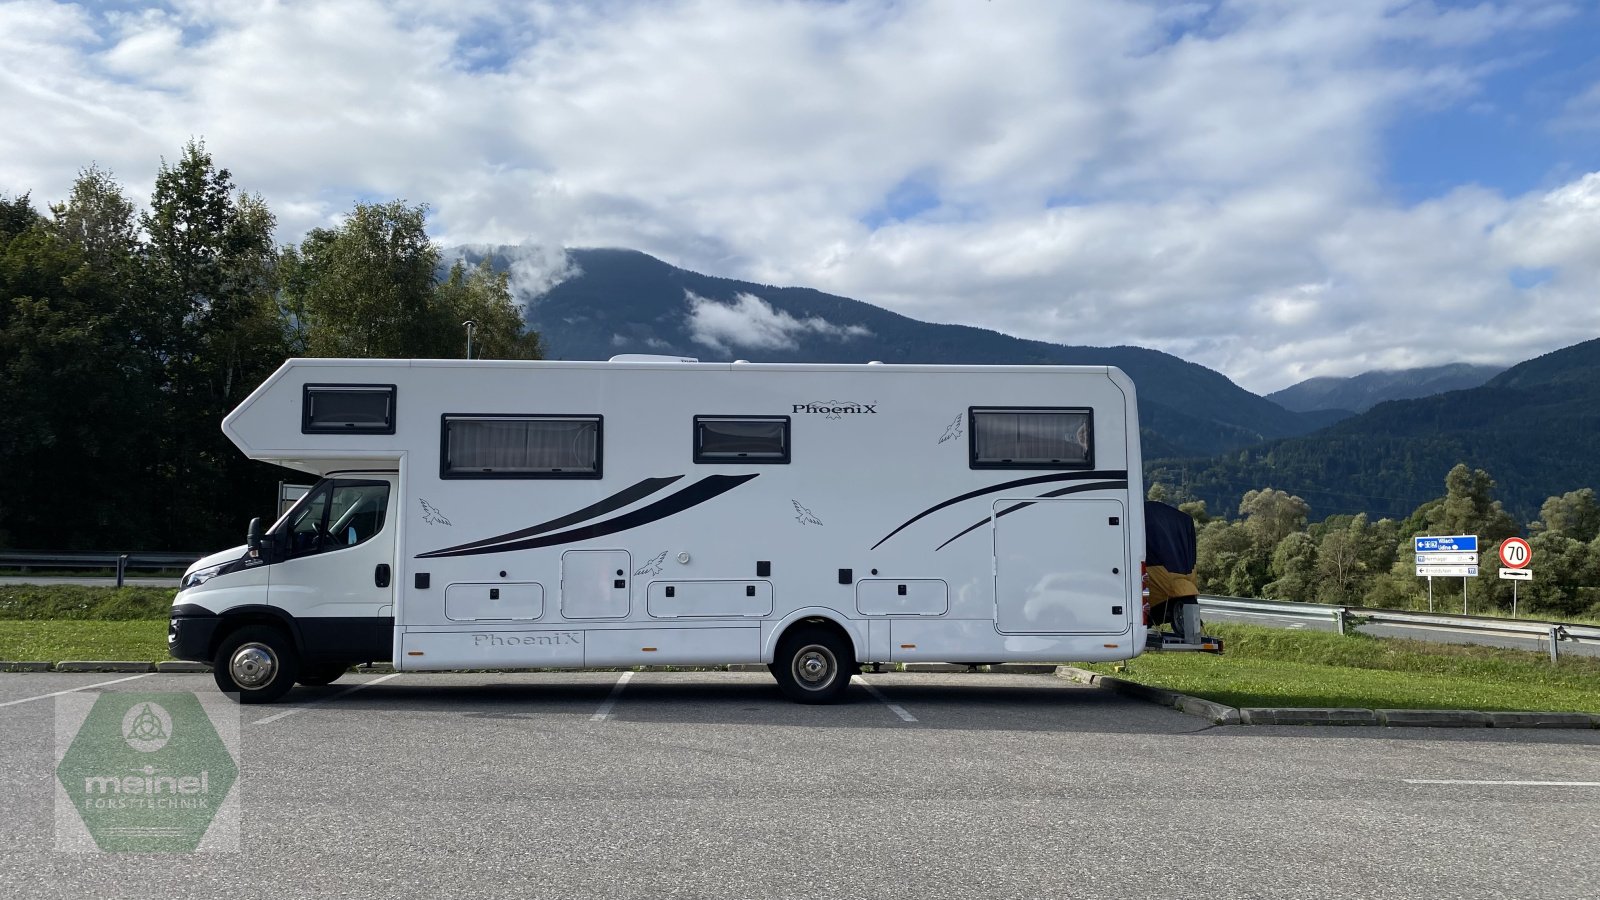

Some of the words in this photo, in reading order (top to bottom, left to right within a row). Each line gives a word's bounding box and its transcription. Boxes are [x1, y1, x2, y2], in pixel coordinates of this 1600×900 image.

[792, 404, 877, 413] PhoeniX
[1508, 546, 1524, 560] 70
[472, 632, 580, 646] PhoeniX
